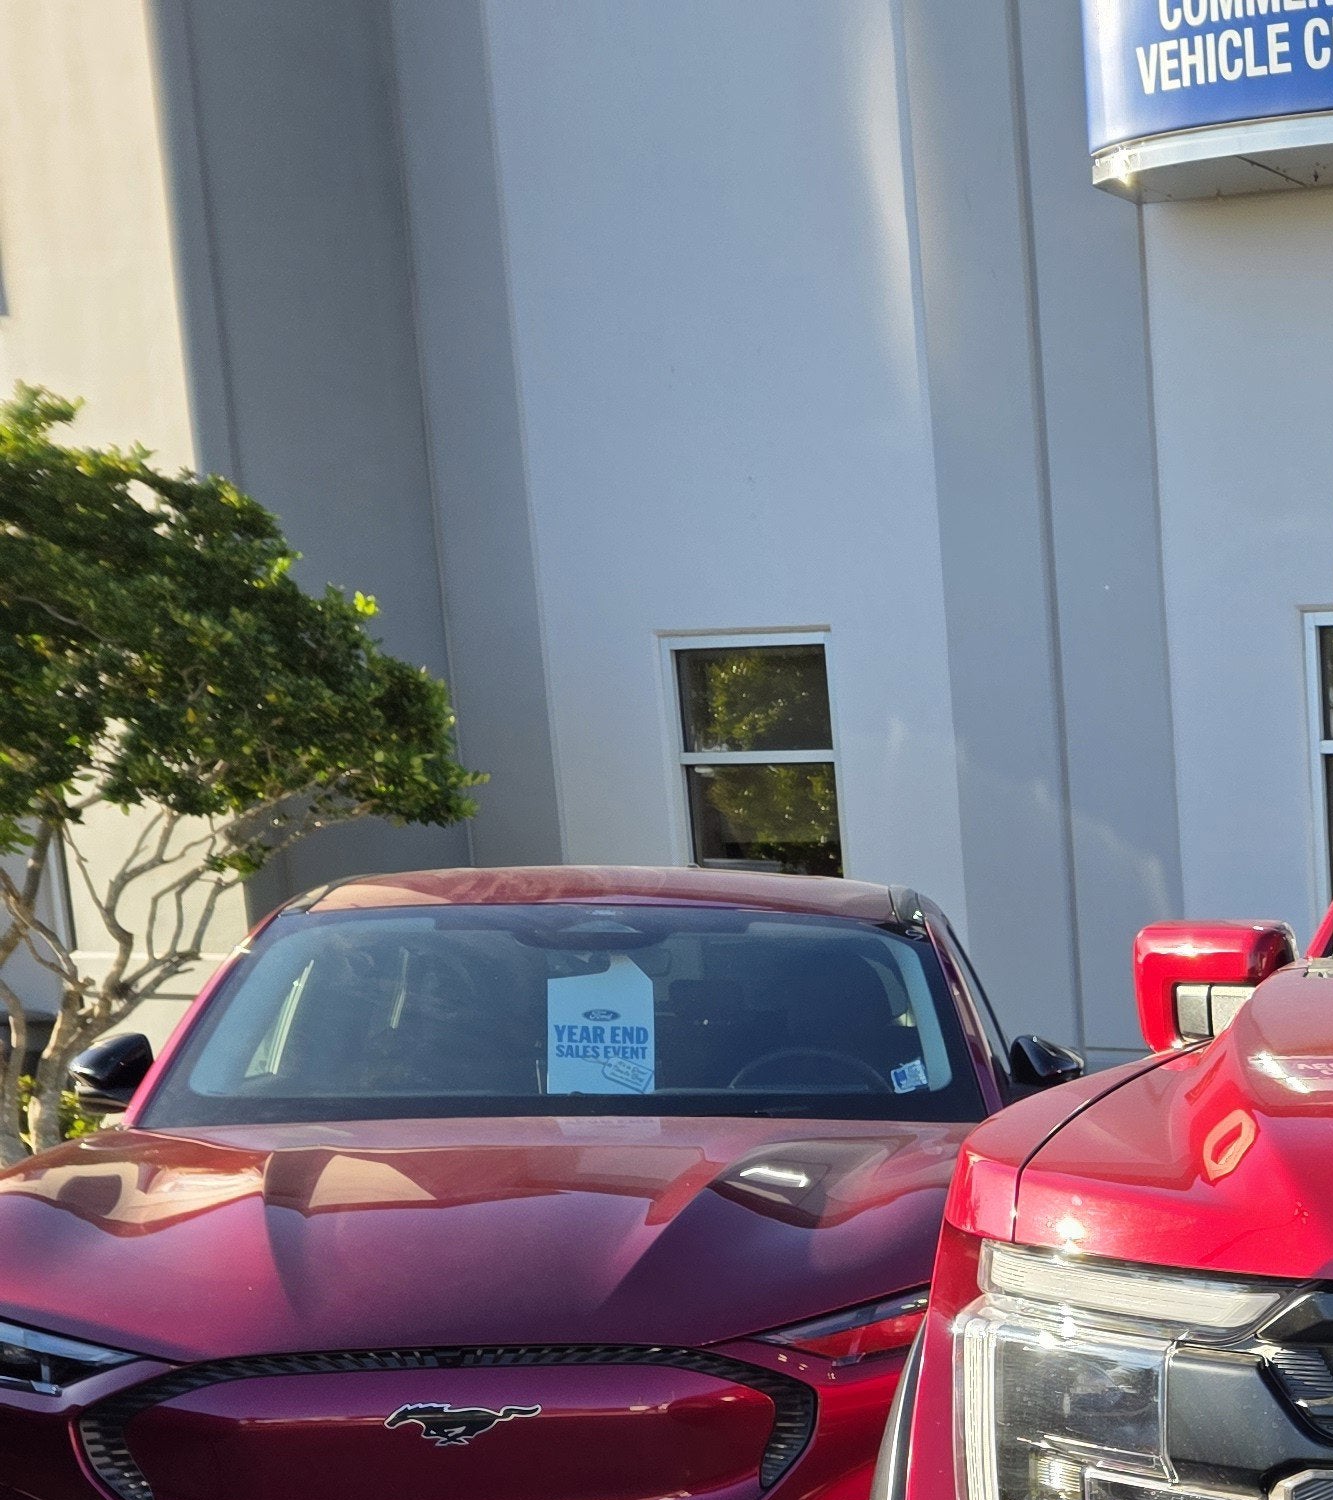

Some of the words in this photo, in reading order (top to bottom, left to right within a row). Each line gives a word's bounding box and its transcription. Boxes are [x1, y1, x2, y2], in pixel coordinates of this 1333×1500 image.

[1136, 22, 1292, 95] VEHICLE
[553, 1024, 605, 1044] YEAR
[610, 1026, 649, 1045] END
[555, 1045, 600, 1059] SALES
[603, 1046, 648, 1060] EVENT
